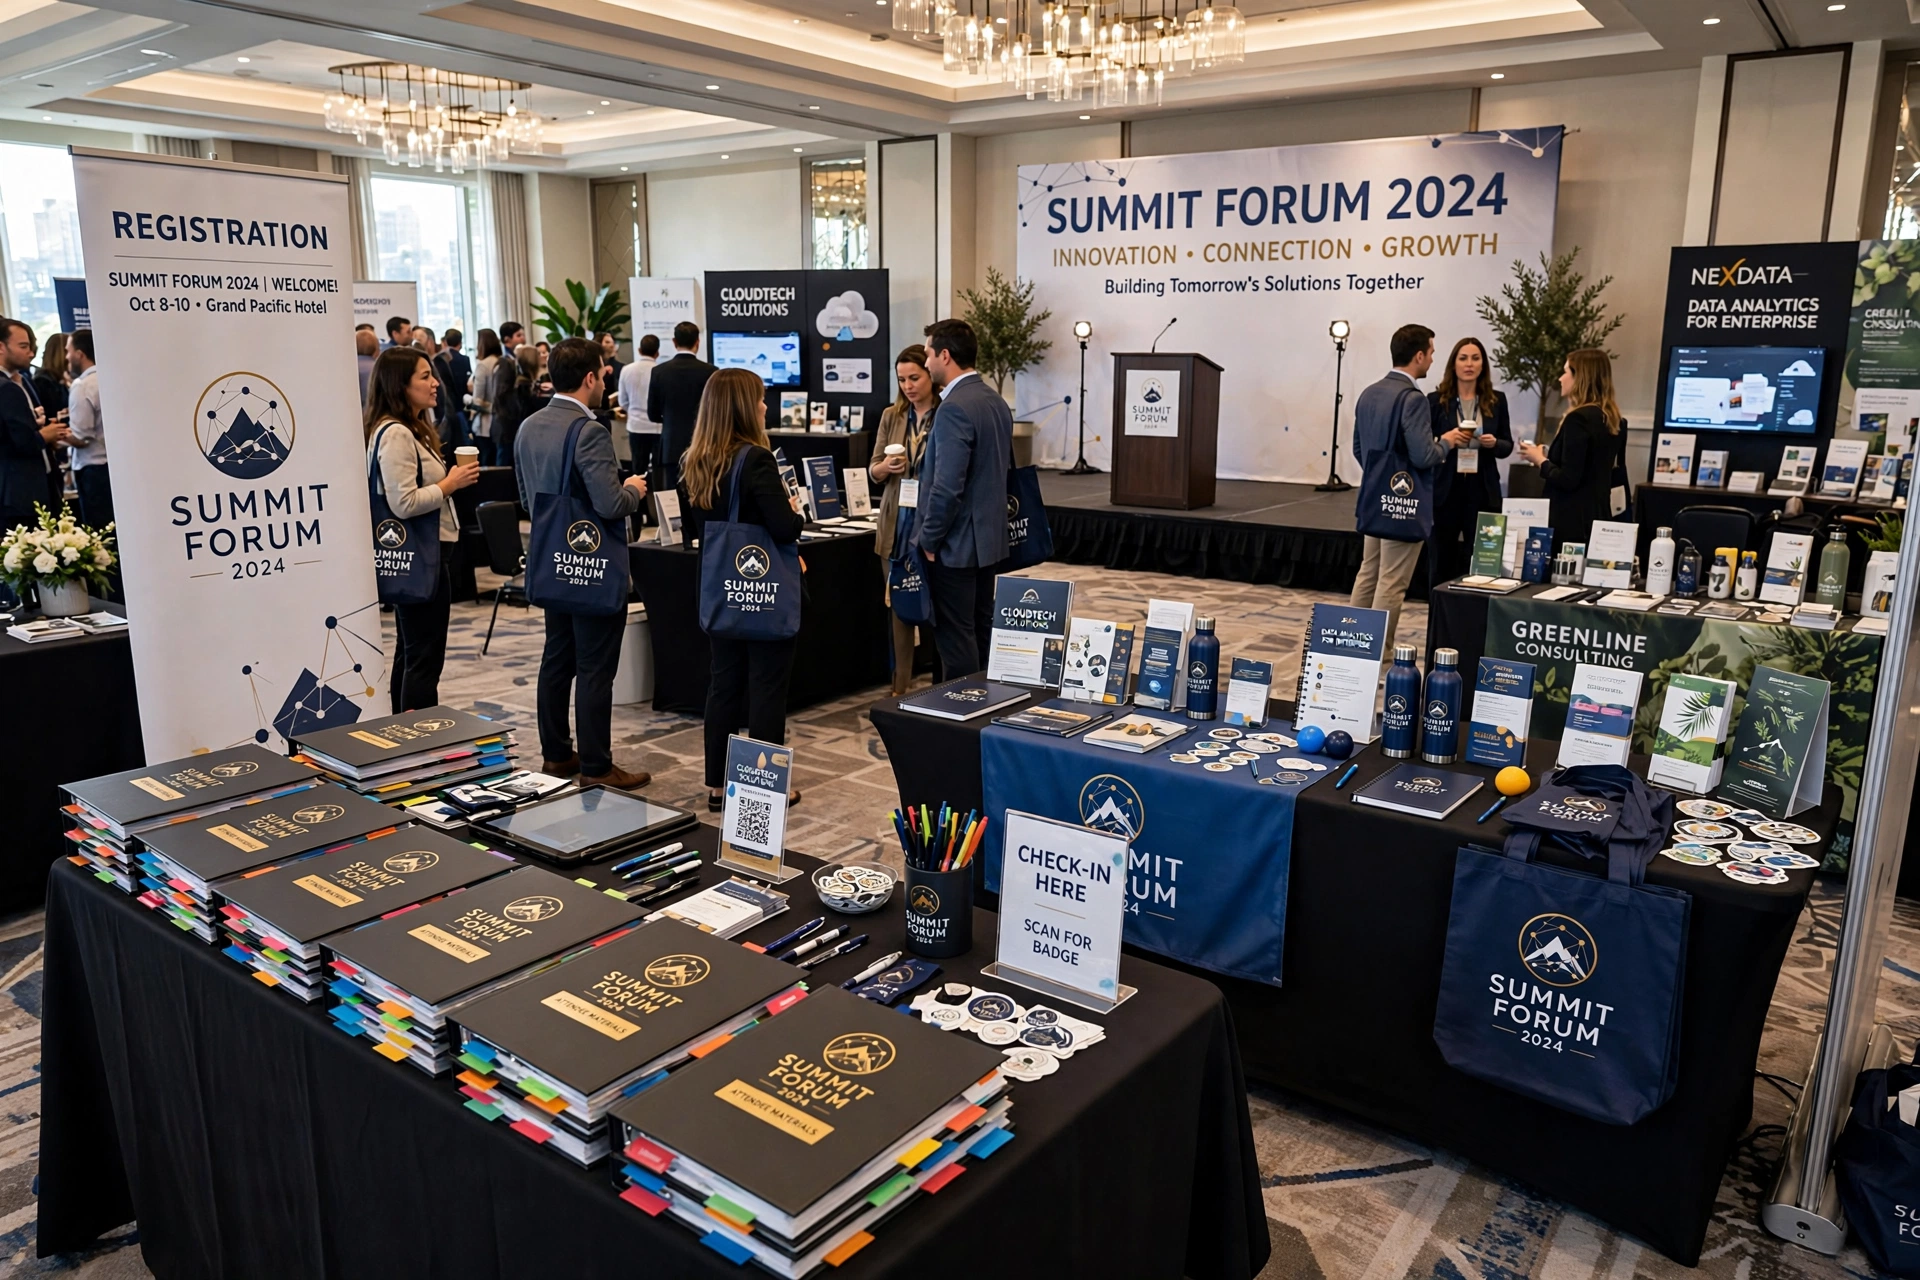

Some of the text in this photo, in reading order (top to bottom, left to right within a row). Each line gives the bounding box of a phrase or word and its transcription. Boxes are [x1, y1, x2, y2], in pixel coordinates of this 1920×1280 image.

[1047, 171, 1508, 234] SUMMIT FORUM 2024
[112, 210, 328, 250] REGISTRATION
[1053, 232, 1498, 267] INNOVATION CONNECTION GROWTH
[108, 272, 339, 293] SUMMIT FORUM 2024 WELCOME!
[1104, 272, 1424, 297] Building Tomorrow's Solutions Together
[1691, 258, 1793, 287] NEXDATA
[129, 296, 327, 314] Oct 8-10 Grand Pacific Hotel
[720, 287, 795, 301] CLOUDTECH
[1688, 297, 1819, 313] DATA ANALYTICS
[721, 303, 789, 316] SOLUTIONS
[1686, 315, 1818, 329] FOR ENTERPRISE
[1132, 405, 1171, 414] SUMMIT
[1135, 414, 1168, 423] FORUM
[170, 484, 328, 526] SUMMIT
[185, 519, 321, 560] FORUM
[373, 549, 414, 561] UMMIT
[374, 559, 410, 570] ORUM
[554, 552, 609, 569] SUMMIT
[232, 557, 285, 580] 2024
[556, 564, 604, 579] FORUM
[724, 579, 779, 593] SUMMIT
[727, 591, 775, 604] FORUM
[1512, 620, 1647, 653] GREENLINE
[350, 861, 405, 886] SUMMIT
[1018, 845, 1111, 884] CHECK-IN
[1128, 848, 1183, 881] MIT
[337, 867, 385, 891] FORUM
[1036, 873, 1086, 902] HERE
[454, 916, 511, 943] FORUM
[466, 908, 533, 938] SUMMIT
[906, 909, 950, 928] SUMMIT
[907, 921, 946, 937] FORUM
[1024, 918, 1092, 950] SCAN FOR
[1033, 940, 1079, 965] BADGE
[592, 981, 660, 1014] FORUM
[603, 970, 683, 1007] SUMMIT
[1489, 973, 1614, 1026] SUMMIT
[1493, 997, 1599, 1047] FORUM
[1520, 1030, 1563, 1053] 2024
[768, 1066, 850, 1109] FORUM
[778, 1053, 875, 1100] SUMMIT
[776, 1087, 810, 1107] 2024
[730, 1088, 819, 1136] ATTENDEE MATERIALS
